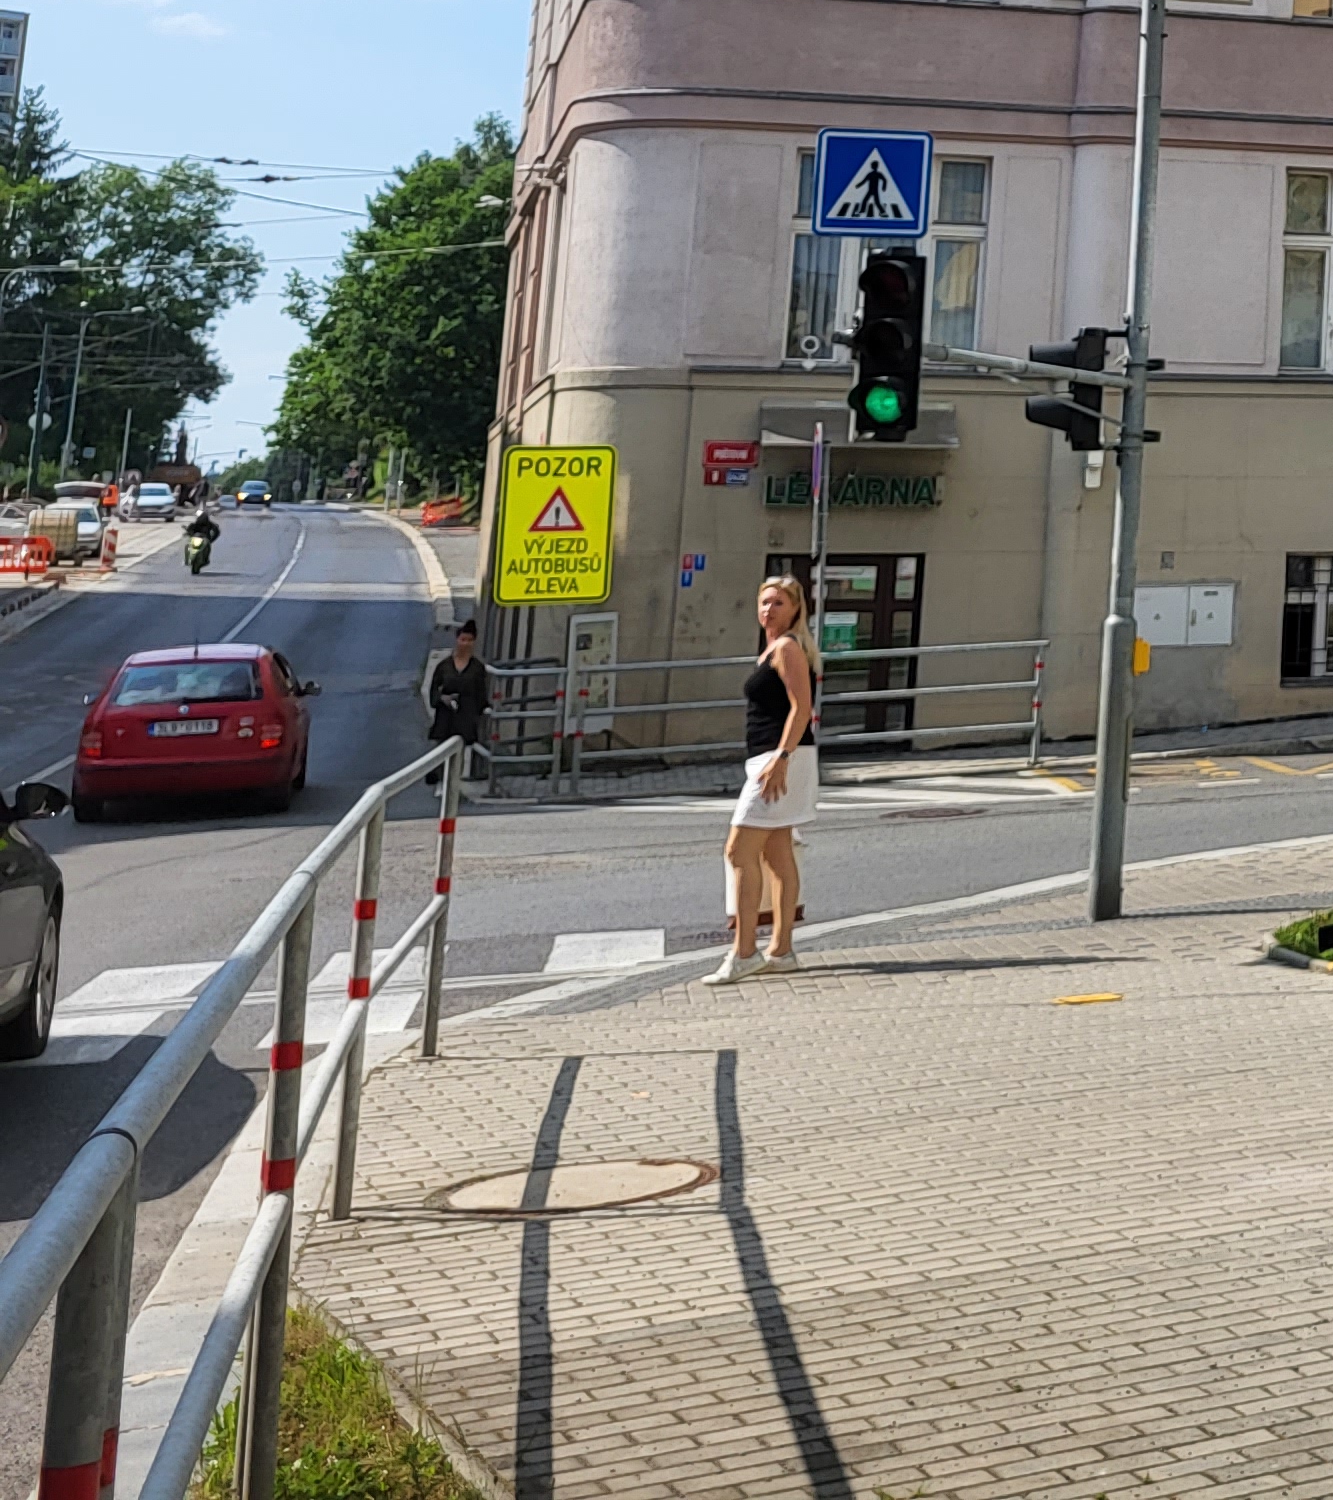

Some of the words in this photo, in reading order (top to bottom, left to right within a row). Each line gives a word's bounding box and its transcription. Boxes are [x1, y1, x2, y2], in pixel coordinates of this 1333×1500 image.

[517, 456, 603, 478] POZOR
[523, 534, 589, 556] VÝJEZD
[506, 552, 602, 577] AUTOBUSŮ
[524, 576, 580, 595] ZLEVA
